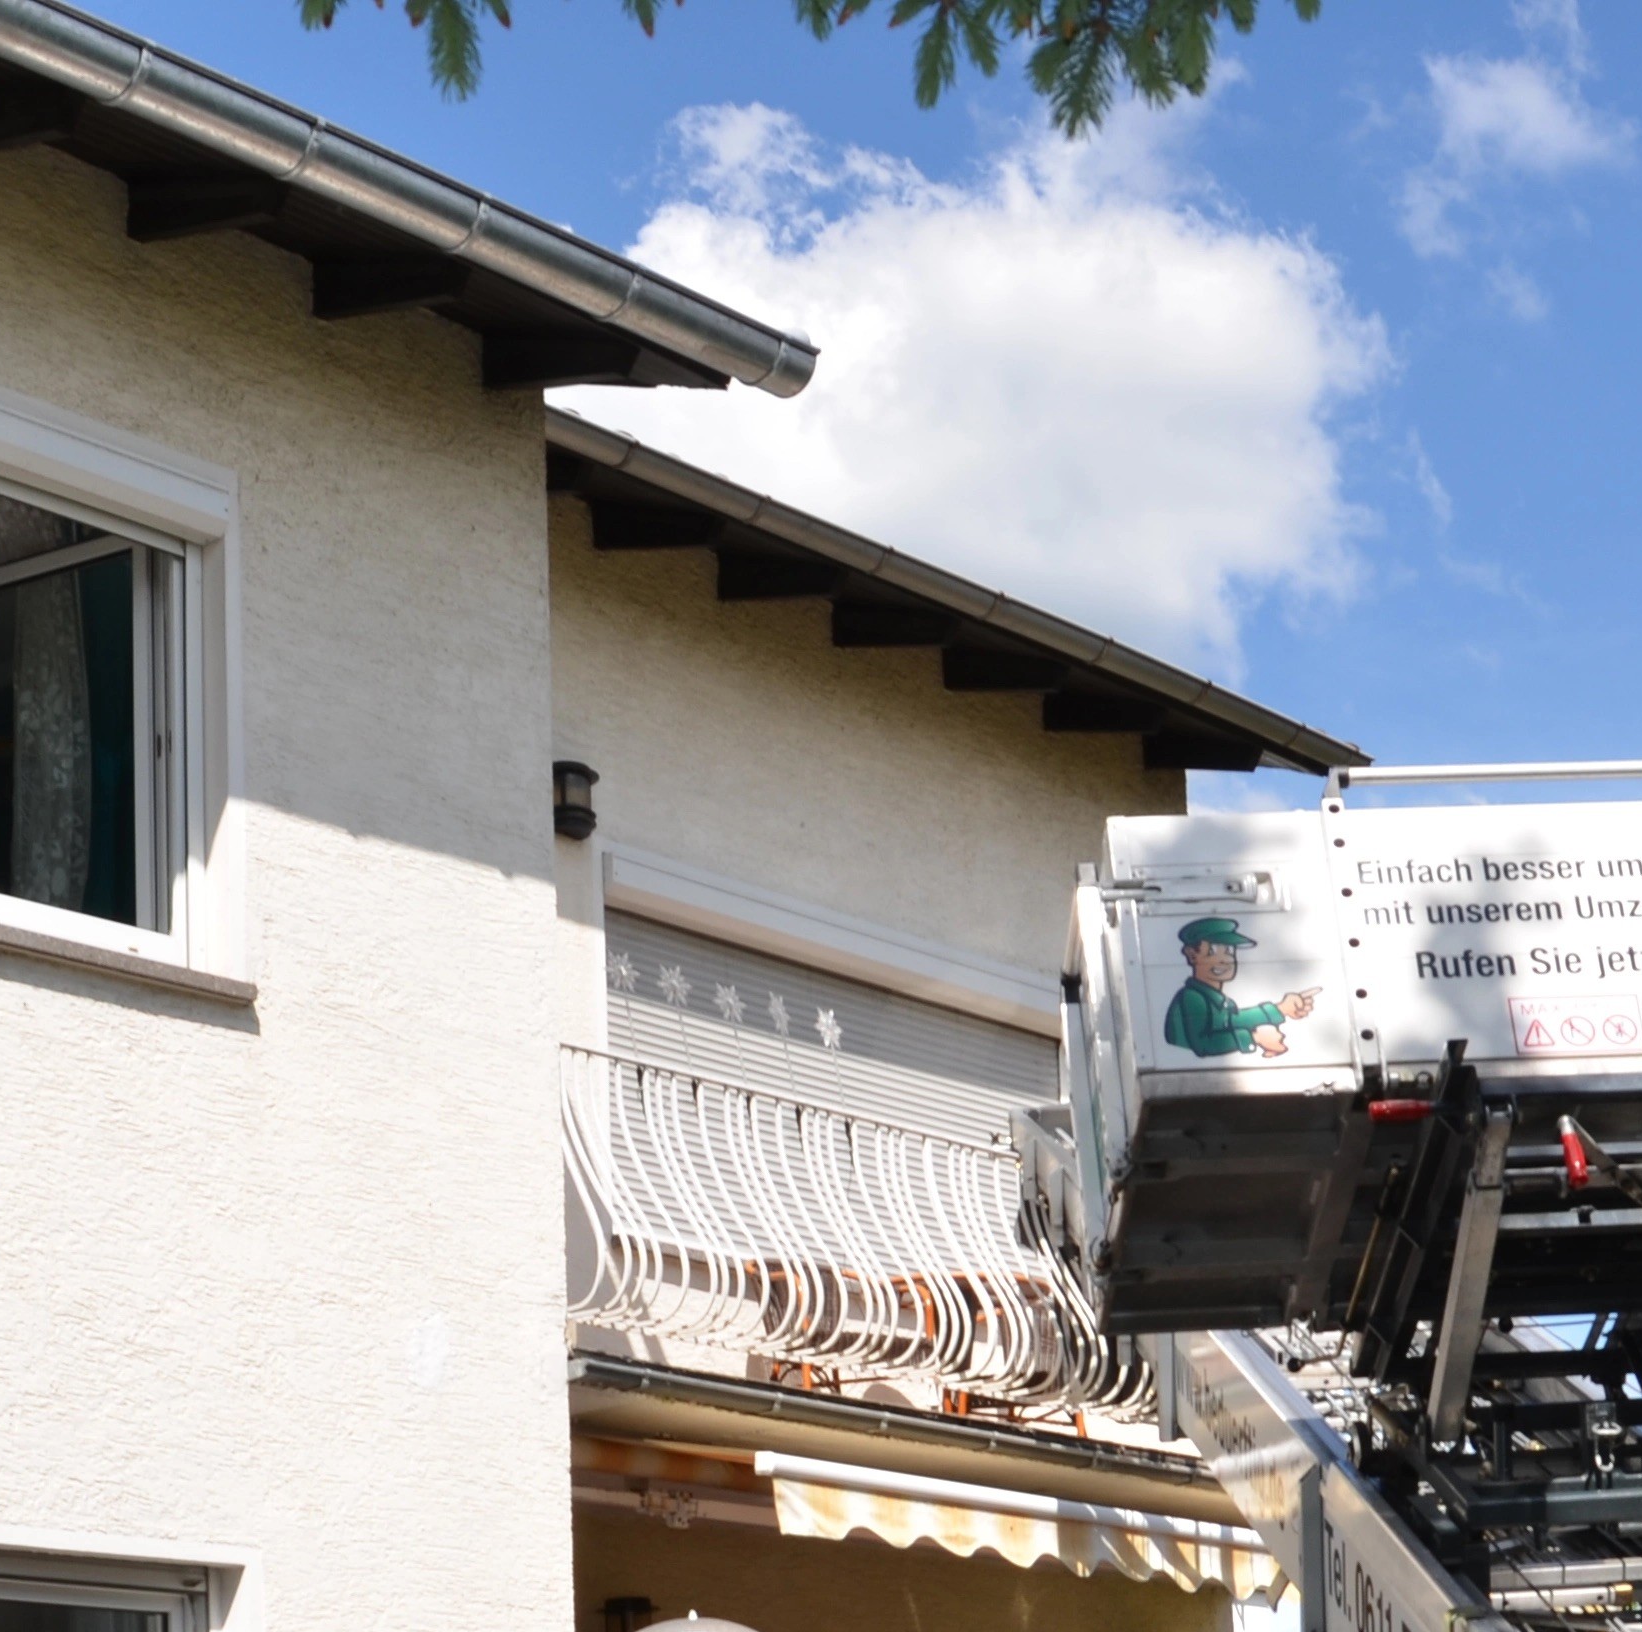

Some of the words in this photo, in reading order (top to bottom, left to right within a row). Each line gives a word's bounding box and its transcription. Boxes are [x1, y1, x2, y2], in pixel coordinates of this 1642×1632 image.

[1356, 859, 1474, 885] Einfach
[1481, 857, 1586, 881] besser
[1363, 901, 1414, 925] mit
[1426, 898, 1564, 925] unserem
[1415, 950, 1517, 980] Rufen
[1529, 946, 1583, 976] Sie
[1324, 1519, 1352, 1623] Tel.
